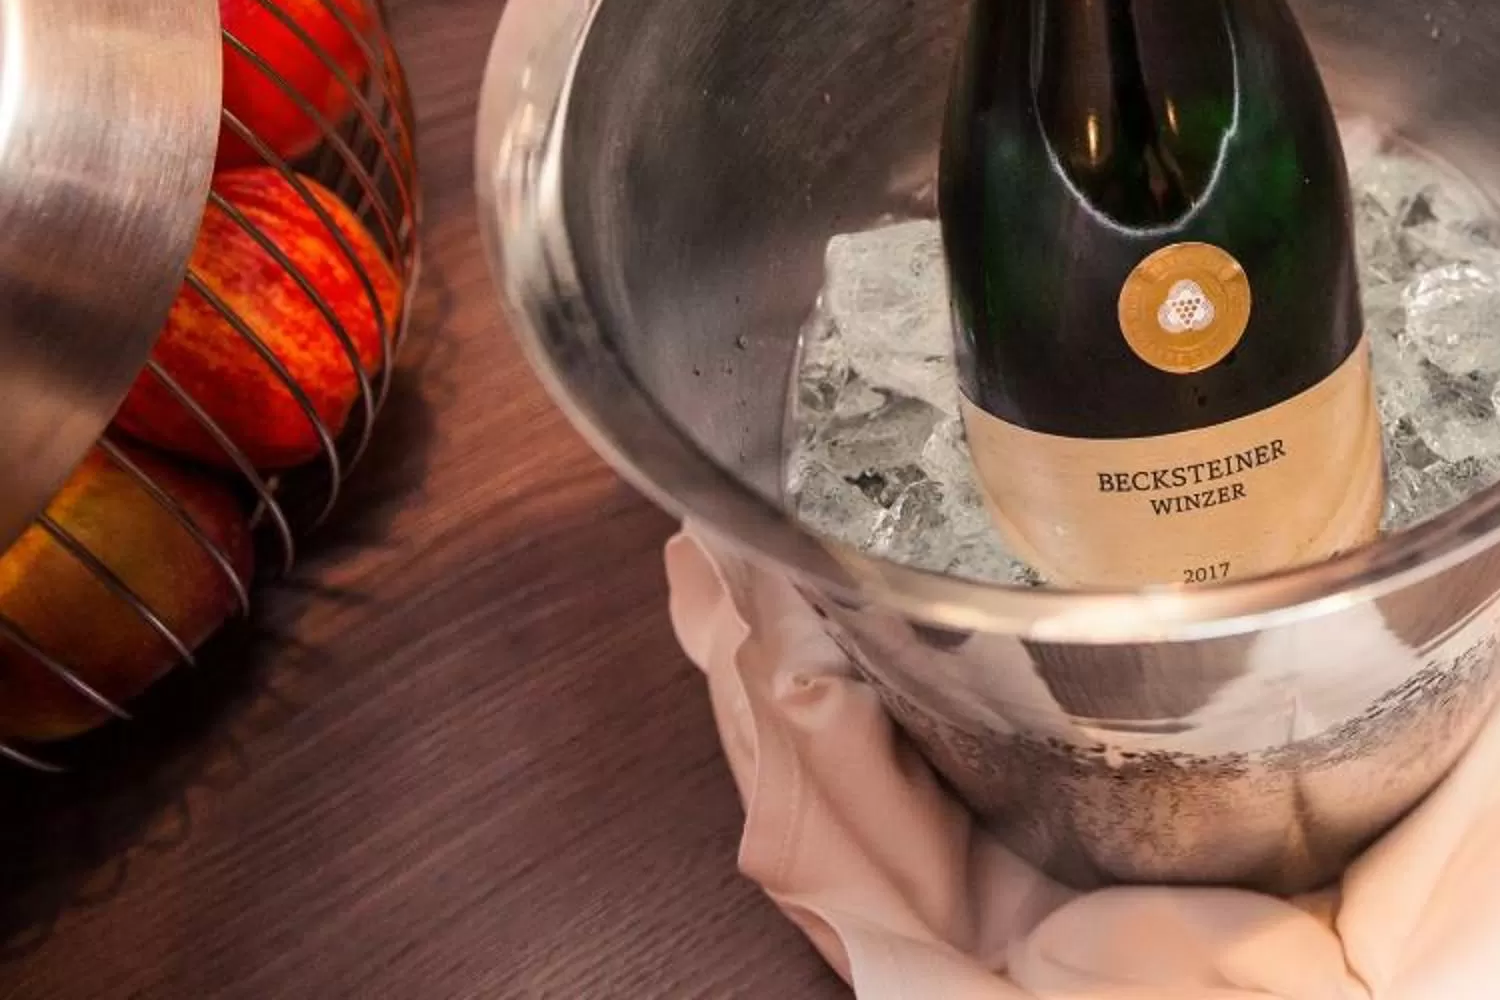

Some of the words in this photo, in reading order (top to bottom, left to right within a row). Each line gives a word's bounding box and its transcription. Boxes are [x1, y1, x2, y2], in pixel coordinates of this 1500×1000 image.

[1097, 439, 1286, 492] BECKSTEINER
[1150, 483, 1247, 516] WINZER
[1184, 563, 1231, 584] 2017
